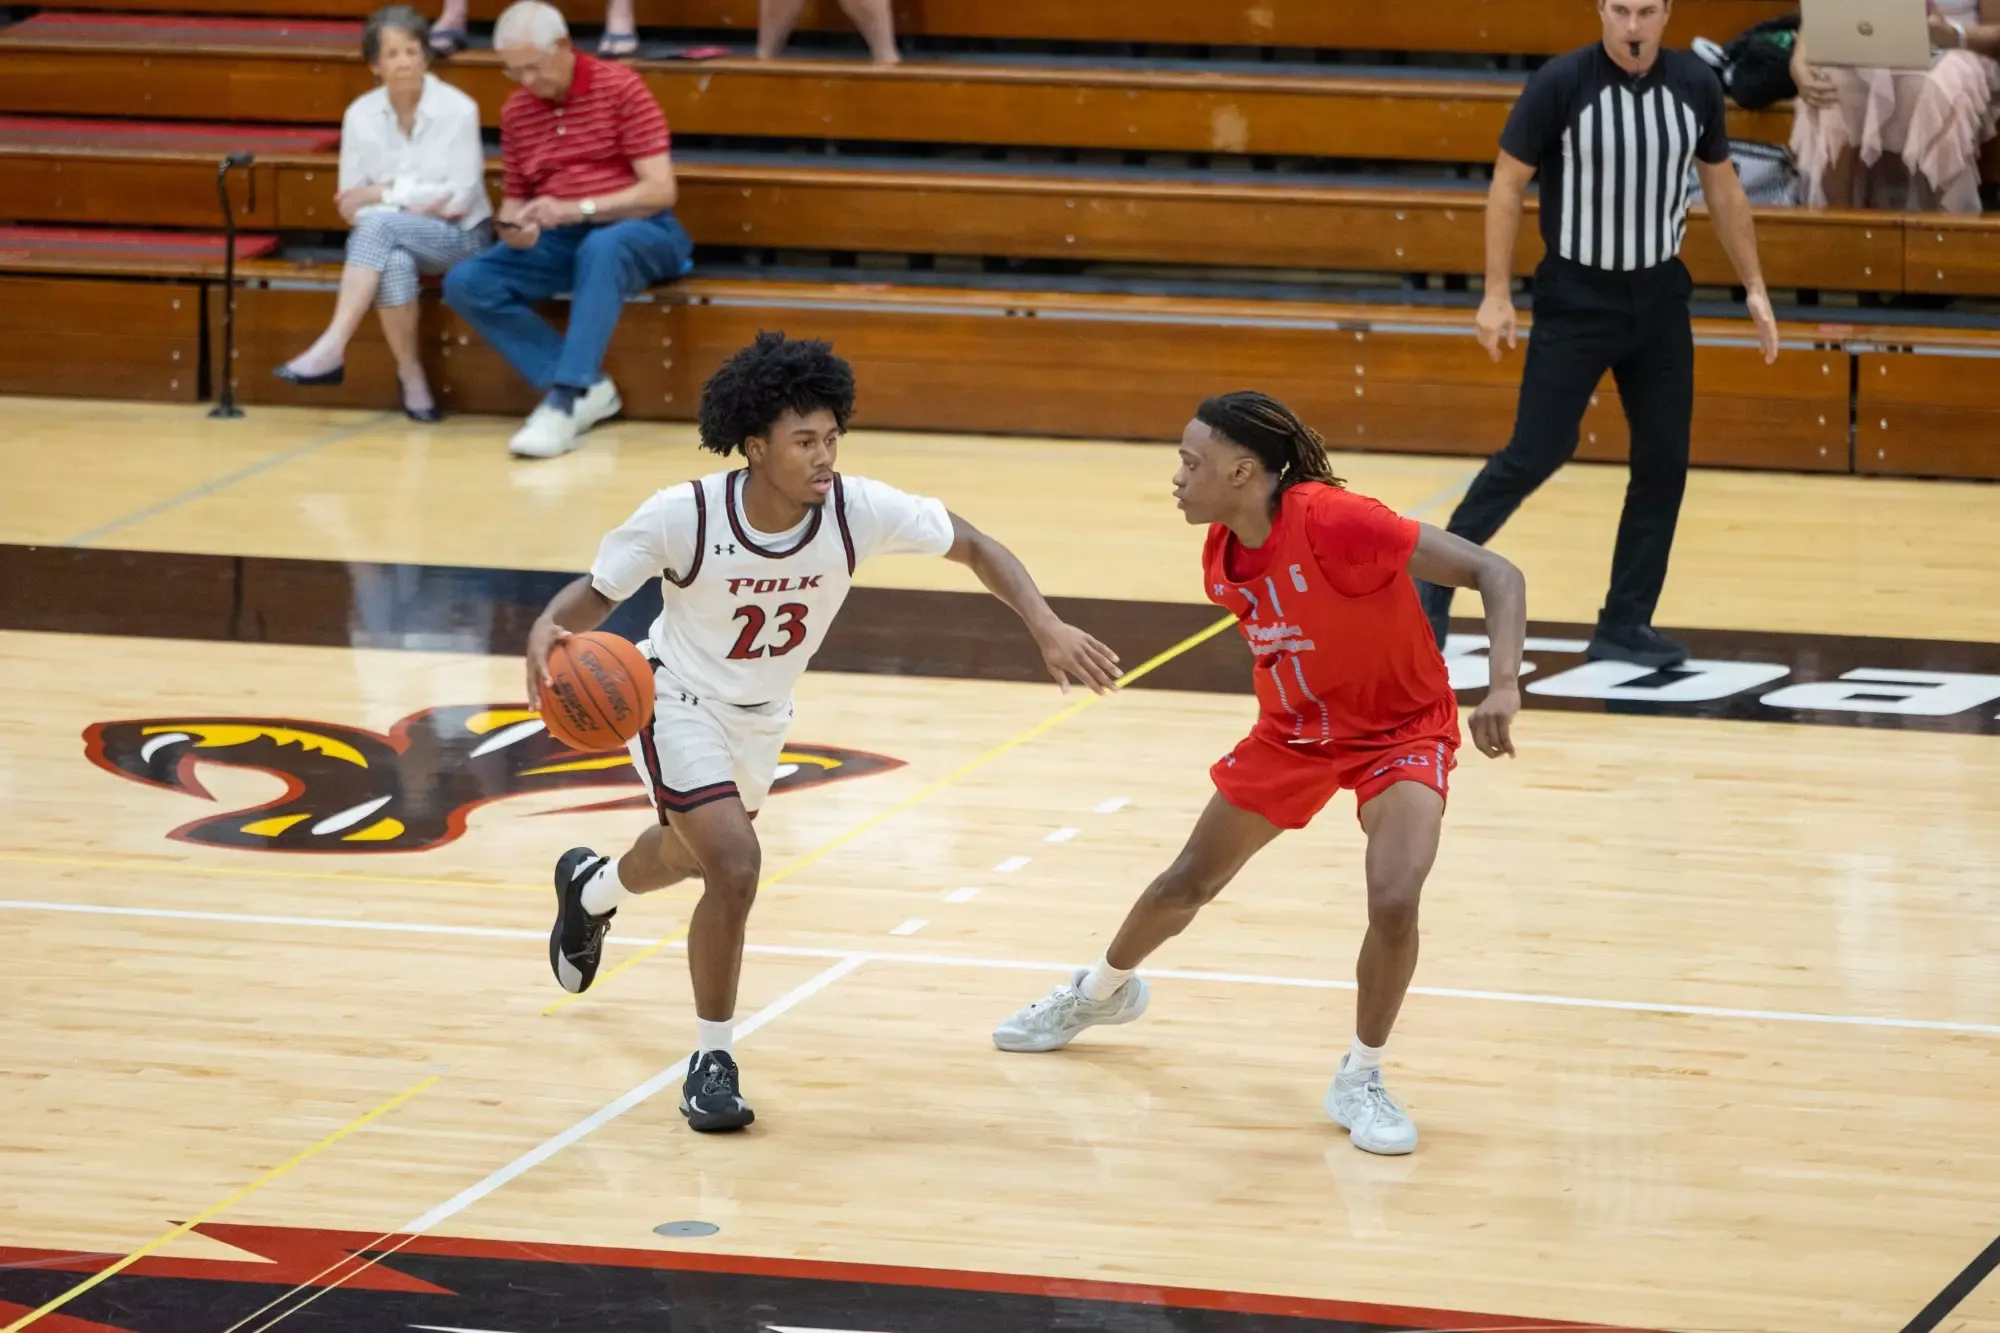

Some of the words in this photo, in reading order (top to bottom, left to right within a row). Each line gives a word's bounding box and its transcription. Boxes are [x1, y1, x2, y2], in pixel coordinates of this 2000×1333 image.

[725, 574, 823, 596] POLK
[1288, 563, 1308, 592] 6
[725, 602, 808, 659] 23
